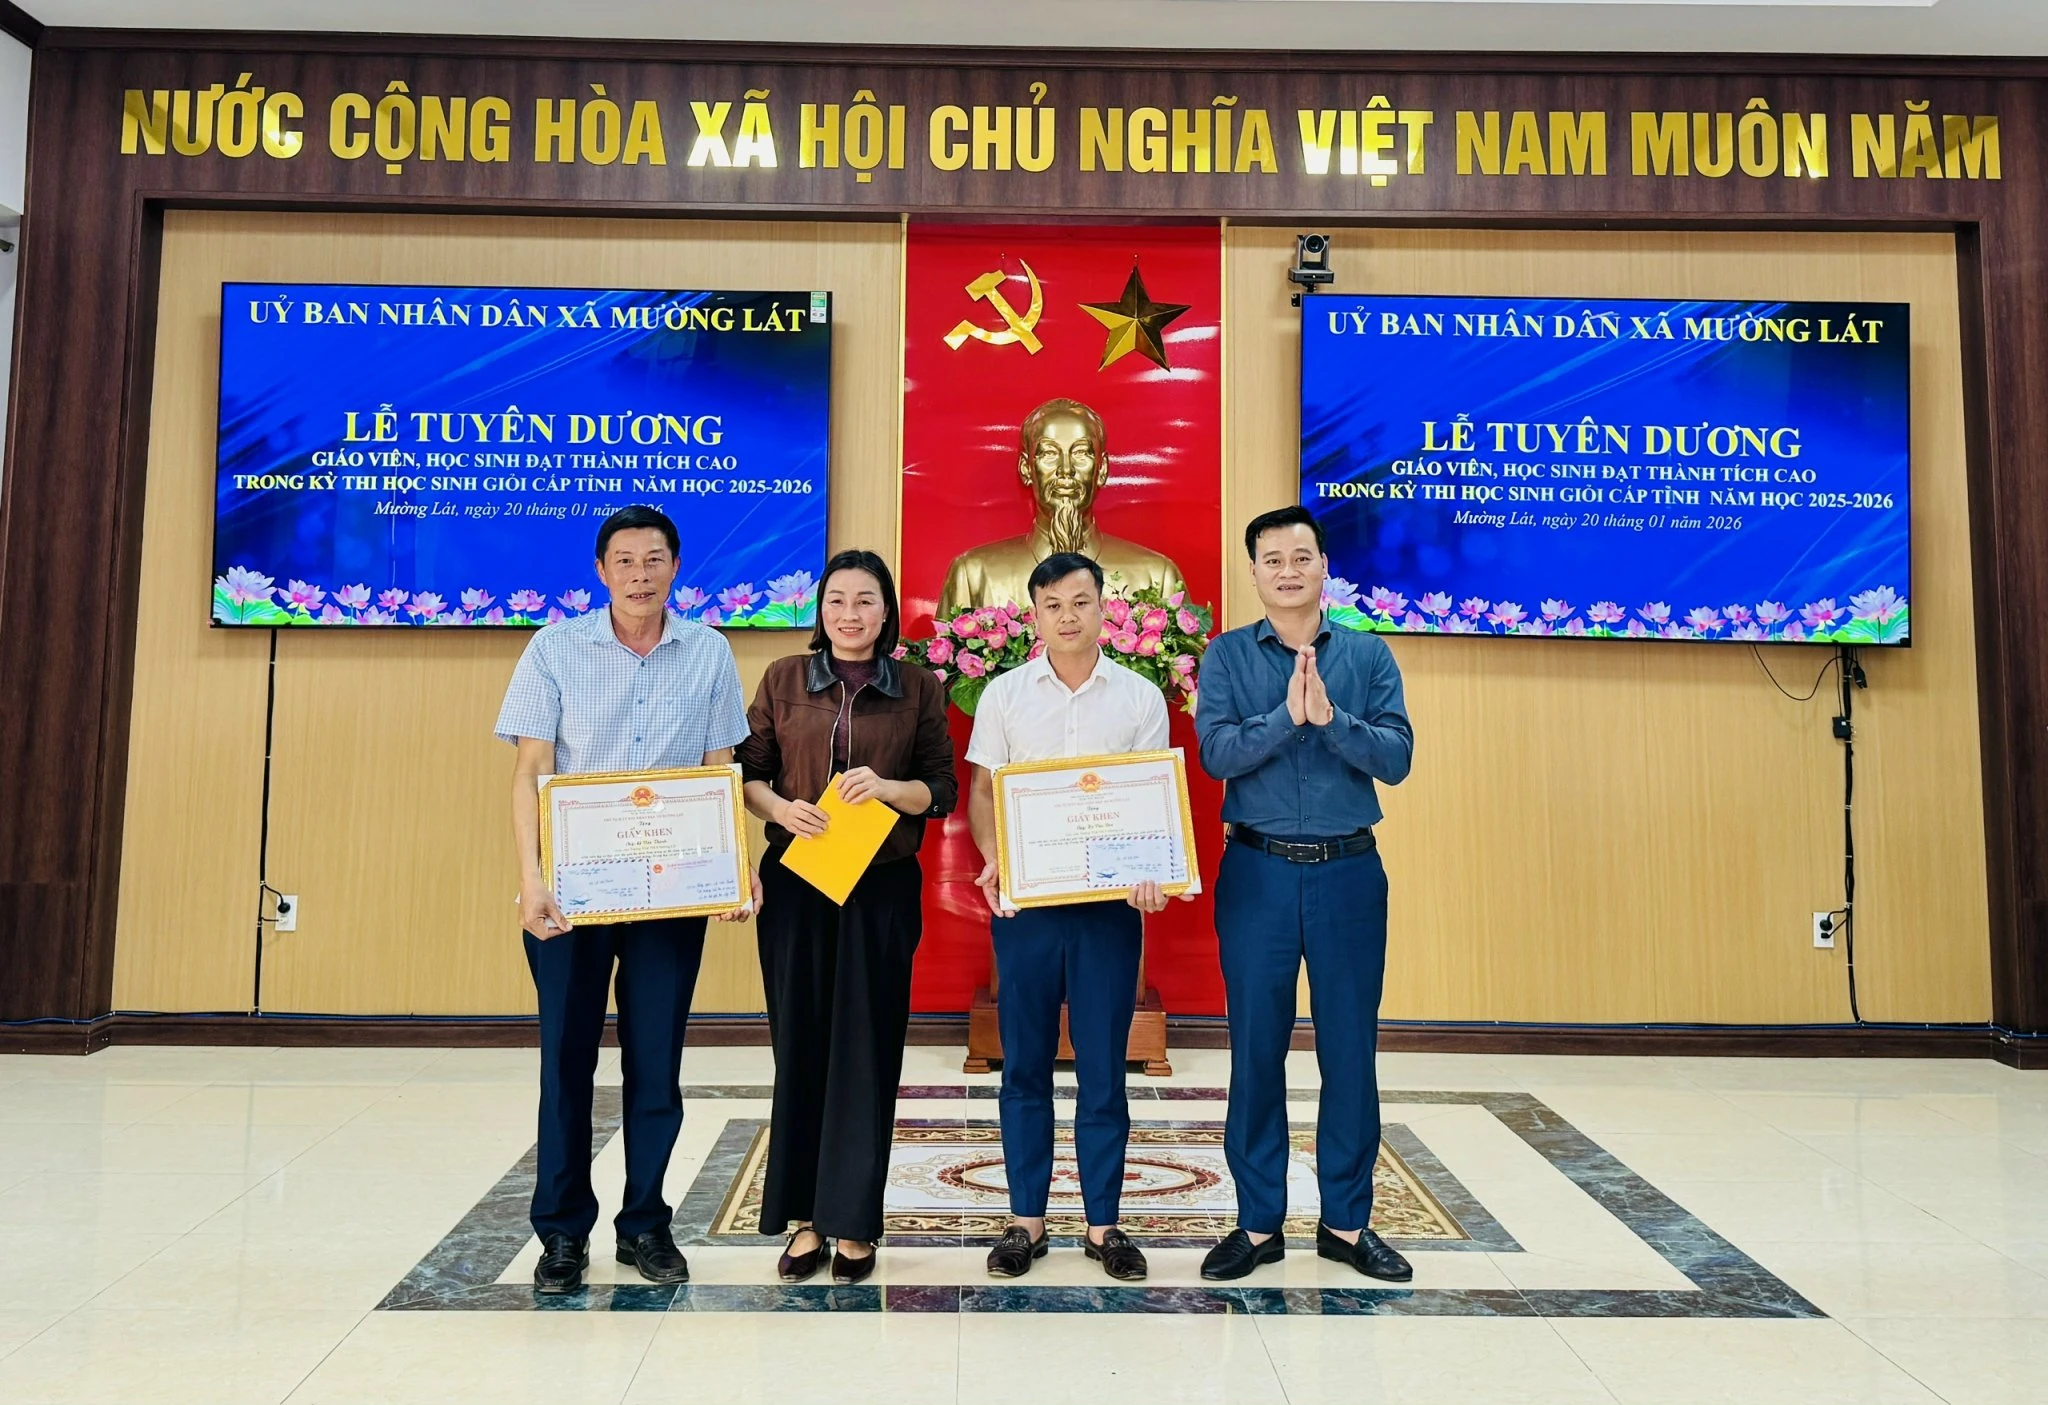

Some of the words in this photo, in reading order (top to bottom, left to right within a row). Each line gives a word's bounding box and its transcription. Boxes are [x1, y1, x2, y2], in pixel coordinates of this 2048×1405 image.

[120, 72, 304, 158] NƯỚC
[329, 80, 511, 175] CỘNG
[534, 83, 667, 166] HÒA
[687, 88, 778, 169] XÃ
[800, 89, 906, 183] HỘI
[929, 81, 1056, 172] CHỦ
[1079, 95, 1278, 174] NGHĨA
[1298, 95, 1433, 186] VIỆT
[1456, 111, 1607, 176] NAM
[1631, 97, 1828, 178] MUÔN
[1851, 99, 2001, 180] NĂM
[249, 294, 295, 324] UỶ
[303, 301, 370, 325] BAN
[378, 297, 472, 326] NHÂN
[480, 298, 549, 328] DÂN
[556, 300, 602, 329] XÃ
[609, 300, 735, 332] MƯỜNG
[741, 302, 806, 332] LÁT
[1327, 305, 1372, 335] UỶ
[1380, 312, 1445, 336] BAN
[1453, 307, 1545, 338] NHÂN
[1552, 309, 1621, 339] DÂN
[1629, 311, 1675, 340] XÃ
[1682, 311, 1812, 343] MƯỜNG
[1817, 312, 1884, 344] LÁT
[342, 403, 399, 442] LỄ
[410, 404, 557, 444] TUYÊN
[567, 410, 724, 446] DƯƠNG
[1421, 412, 1476, 452] LỄ
[1486, 415, 1632, 455] TUYÊN
[1642, 421, 1802, 459] DƯƠNG
[311, 447, 364, 467] GIÁO
[367, 448, 421, 470] VIÊN,
[425, 452, 470, 471] HỌC
[474, 453, 520, 468] SINH
[526, 454, 565, 472] ĐẠT
[569, 450, 638, 469] THÀNH
[643, 451, 691, 470] TÍCH
[695, 455, 738, 471] CAO
[1391, 456, 1443, 476] GIÁO
[1446, 457, 1498, 480] VIÊN,
[1503, 463, 1546, 481] HỌC
[1550, 464, 1596, 479] SINH
[1602, 466, 1641, 483] ĐẠT
[1645, 462, 1716, 481] THÀNH
[1720, 463, 1769, 482] TÍCH
[1773, 468, 1817, 484] CAO
[232, 474, 305, 490] TRONG
[308, 471, 338, 490] KỲ
[341, 475, 378, 491] THI
[383, 476, 426, 494] HỌC
[431, 476, 477, 491] SINH
[482, 473, 527, 492] GIỎI
[531, 473, 571, 492] CẤP
[574, 474, 622, 492] TỈNH
[632, 475, 676, 493] NĂM
[682, 478, 724, 497] HỌC
[728, 479, 813, 494] 2025-2026
[1315, 482, 1385, 499] TRONG
[1389, 479, 1418, 499] KỲ
[1421, 484, 1456, 500] THI
[1461, 485, 1504, 505] HỌC
[1508, 486, 1554, 502] SINH
[1710, 487, 1755, 506] NĂM
[1760, 491, 1804, 511] HỌC
[1808, 492, 1894, 509] 2025-2026
[374, 501, 428, 518] Mường
[431, 501, 459, 517] Lát,
[464, 502, 500, 519] ngày
[504, 503, 523, 516] 20
[526, 502, 567, 520] tháng
[571, 503, 588, 516] 01
[1453, 510, 1506, 529] Mường
[1509, 511, 1537, 527] Lát,
[1542, 512, 1578, 530] ngày
[1581, 513, 1600, 526] 20
[1603, 513, 1645, 532] tháng
[1648, 514, 1666, 528] 01
[1670, 515, 1701, 529] năm
[1706, 515, 1742, 530] 2026
[1092, 811, 1120, 822] KHEN
[643, 827, 673, 838] KHEN
